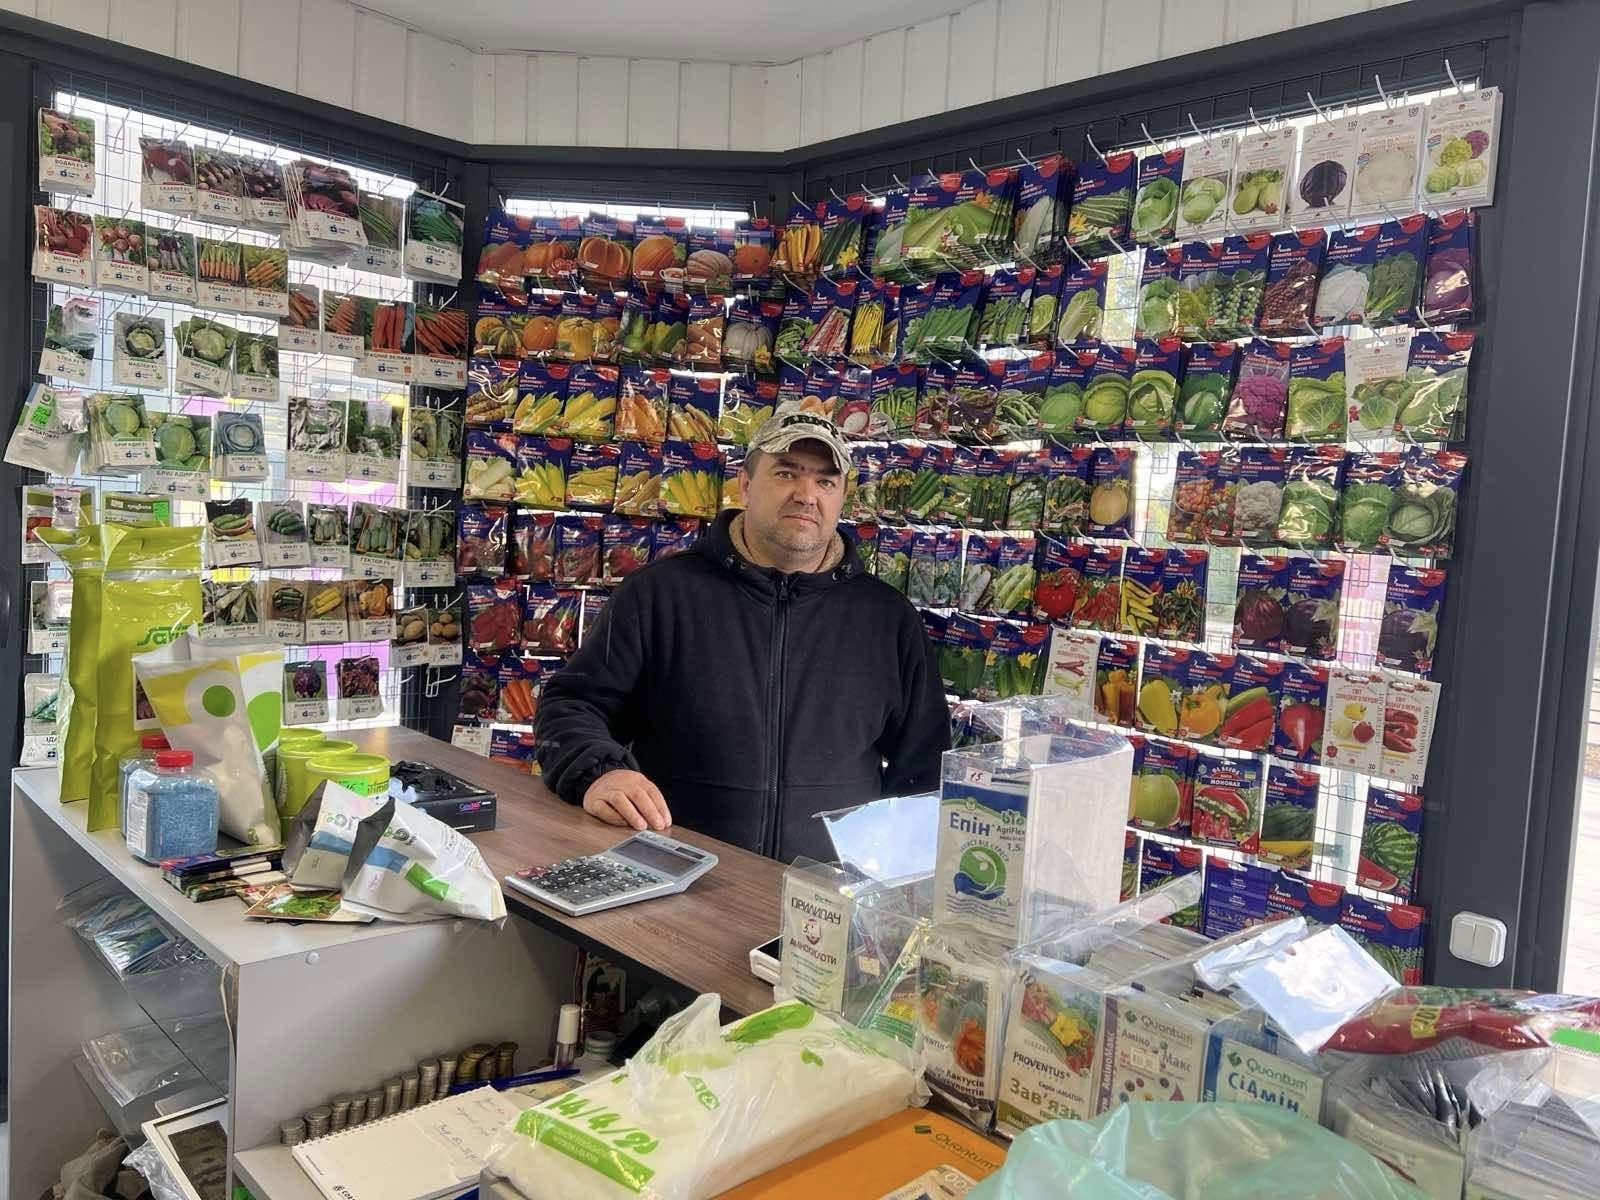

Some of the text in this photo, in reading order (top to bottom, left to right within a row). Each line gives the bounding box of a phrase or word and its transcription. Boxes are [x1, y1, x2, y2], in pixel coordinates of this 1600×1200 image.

[1141, 1014, 1193, 1046] Quantum
[1246, 1057, 1309, 1091] Quantum
[935, 1132, 995, 1170] Quantum
